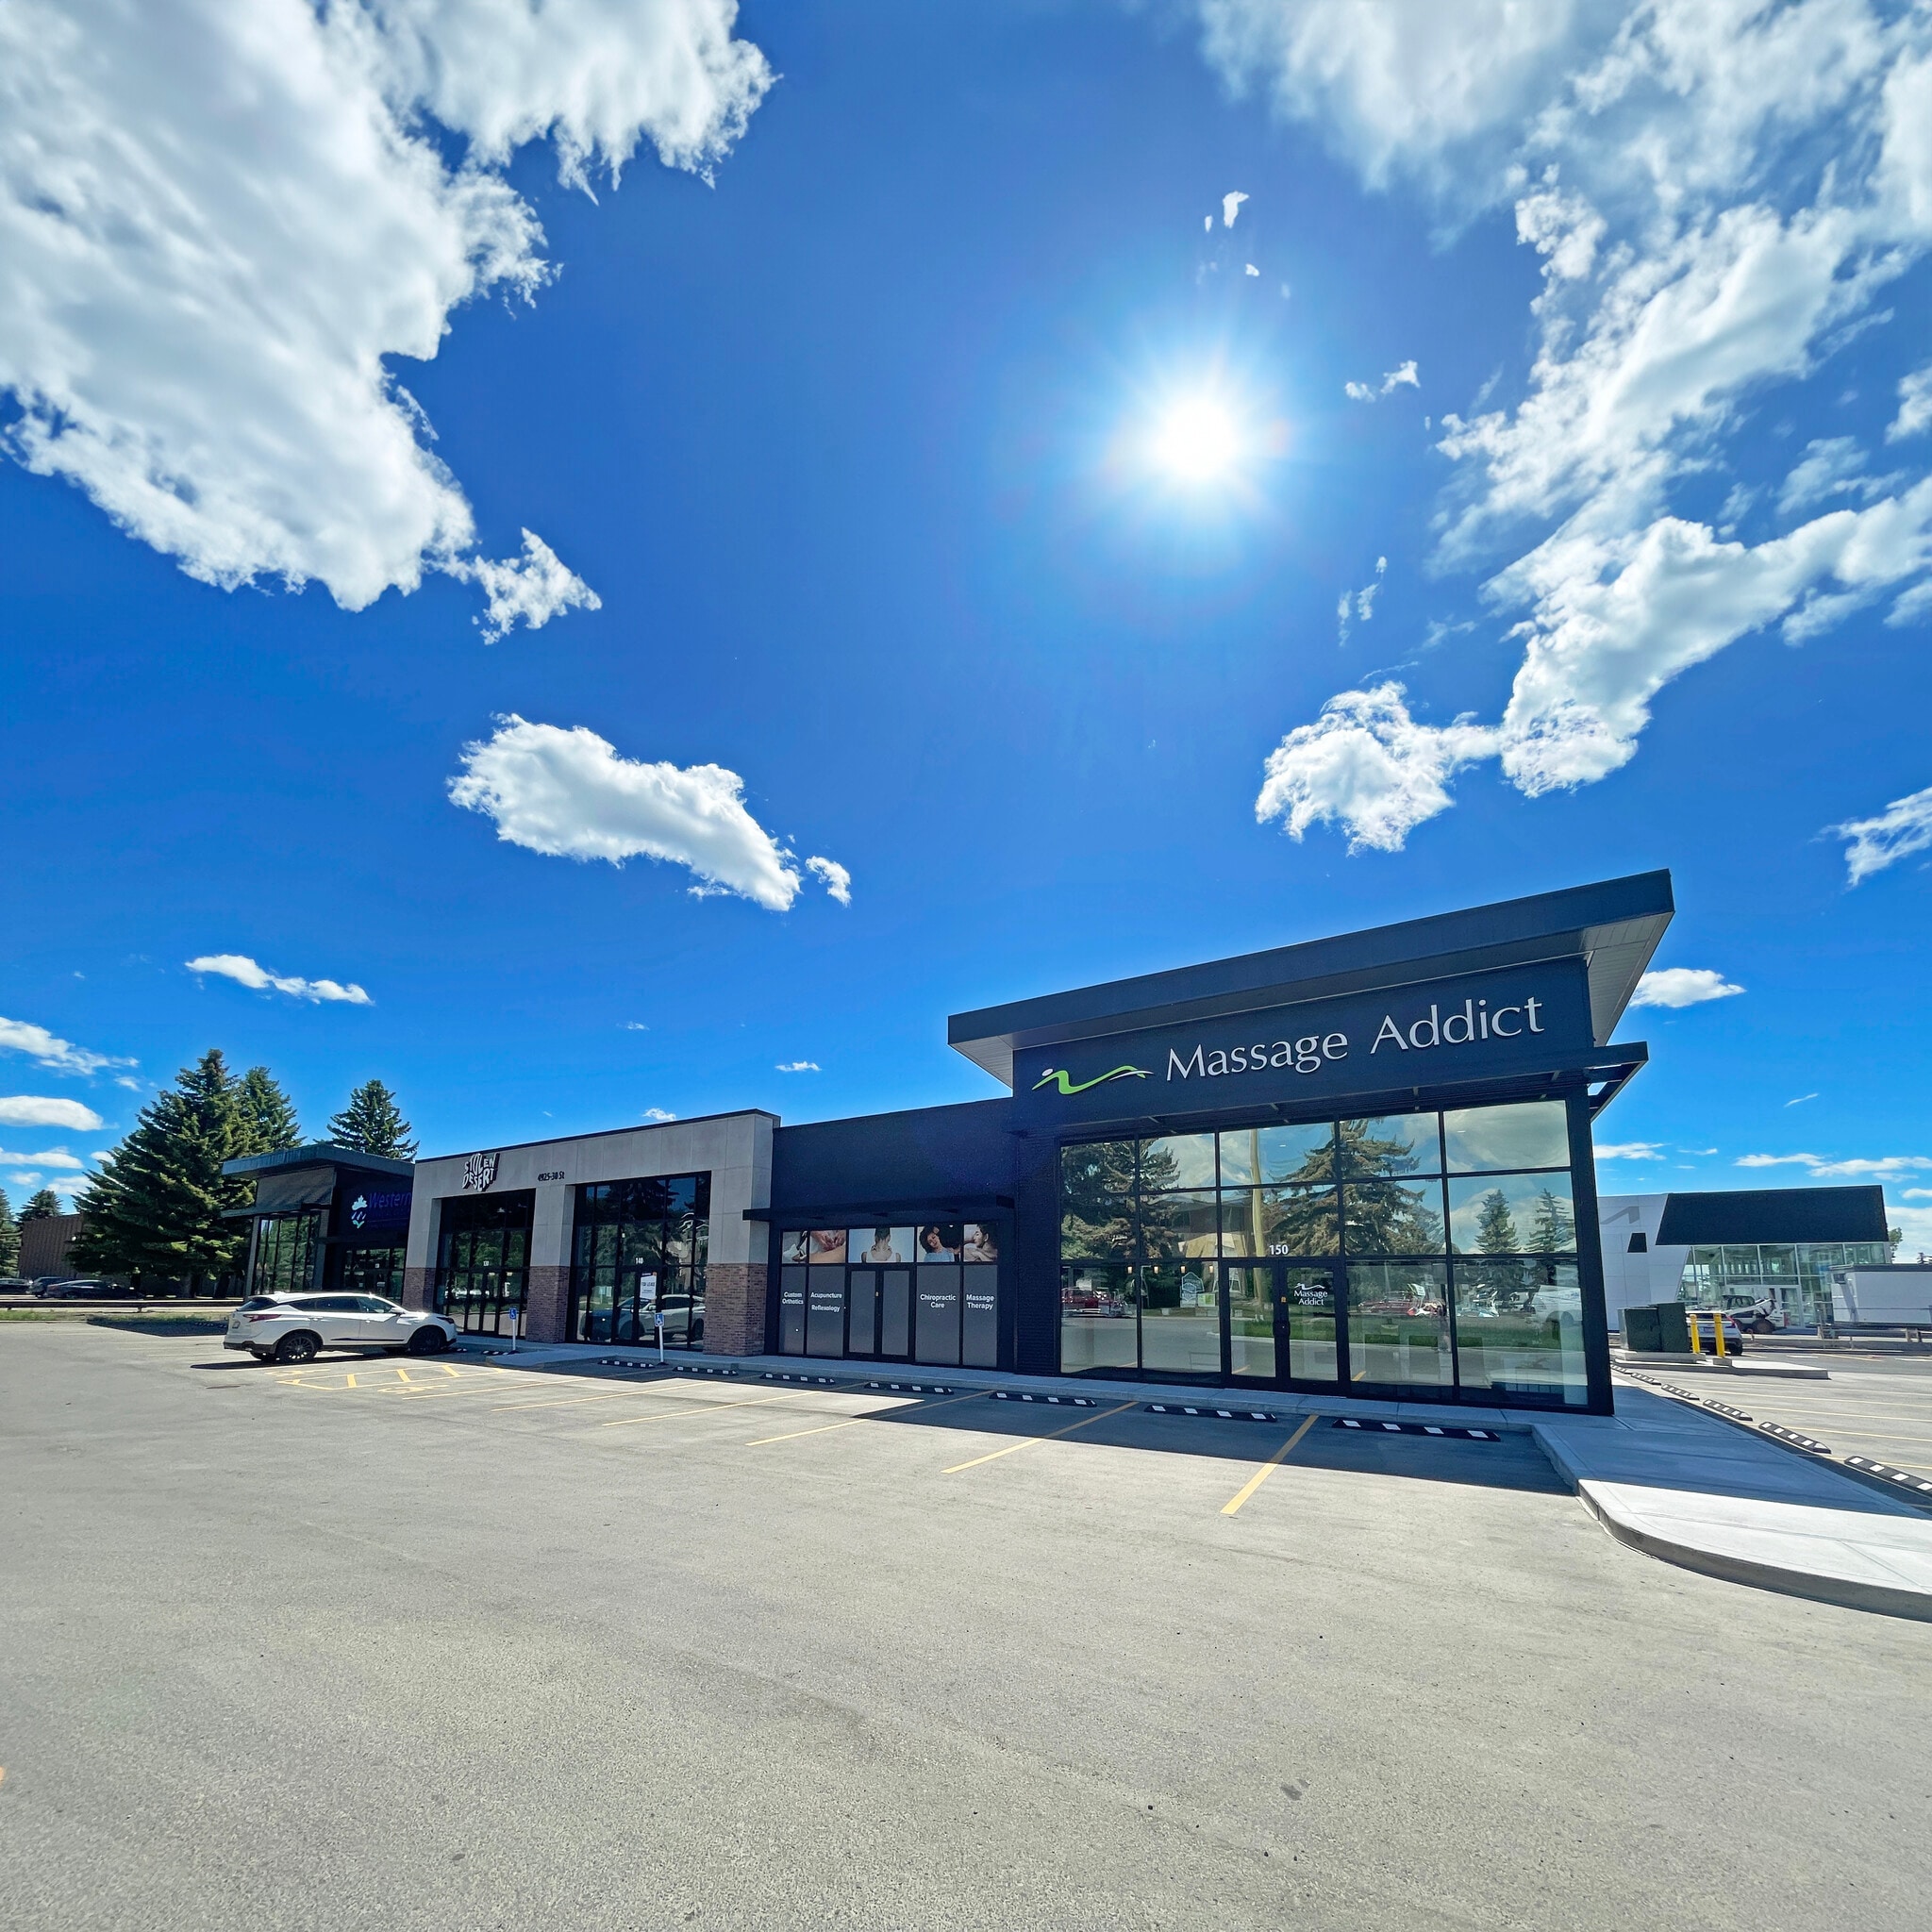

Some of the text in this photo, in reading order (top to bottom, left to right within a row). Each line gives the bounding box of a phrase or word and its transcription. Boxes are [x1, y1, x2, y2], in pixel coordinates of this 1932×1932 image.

[1166, 996, 1546, 1082] Massage Addict
[464, 1152, 499, 1174] STOLEN
[462, 1168, 497, 1191] DESERT
[368, 1191, 411, 1208] Western
[1269, 1244, 1289, 1256] 150
[920, 1293, 957, 1302] Chiropractic
[1293, 1290, 1328, 1299] Massage
[967, 1302, 993, 1310] Therapy
[1298, 1297, 1324, 1306] Addict
